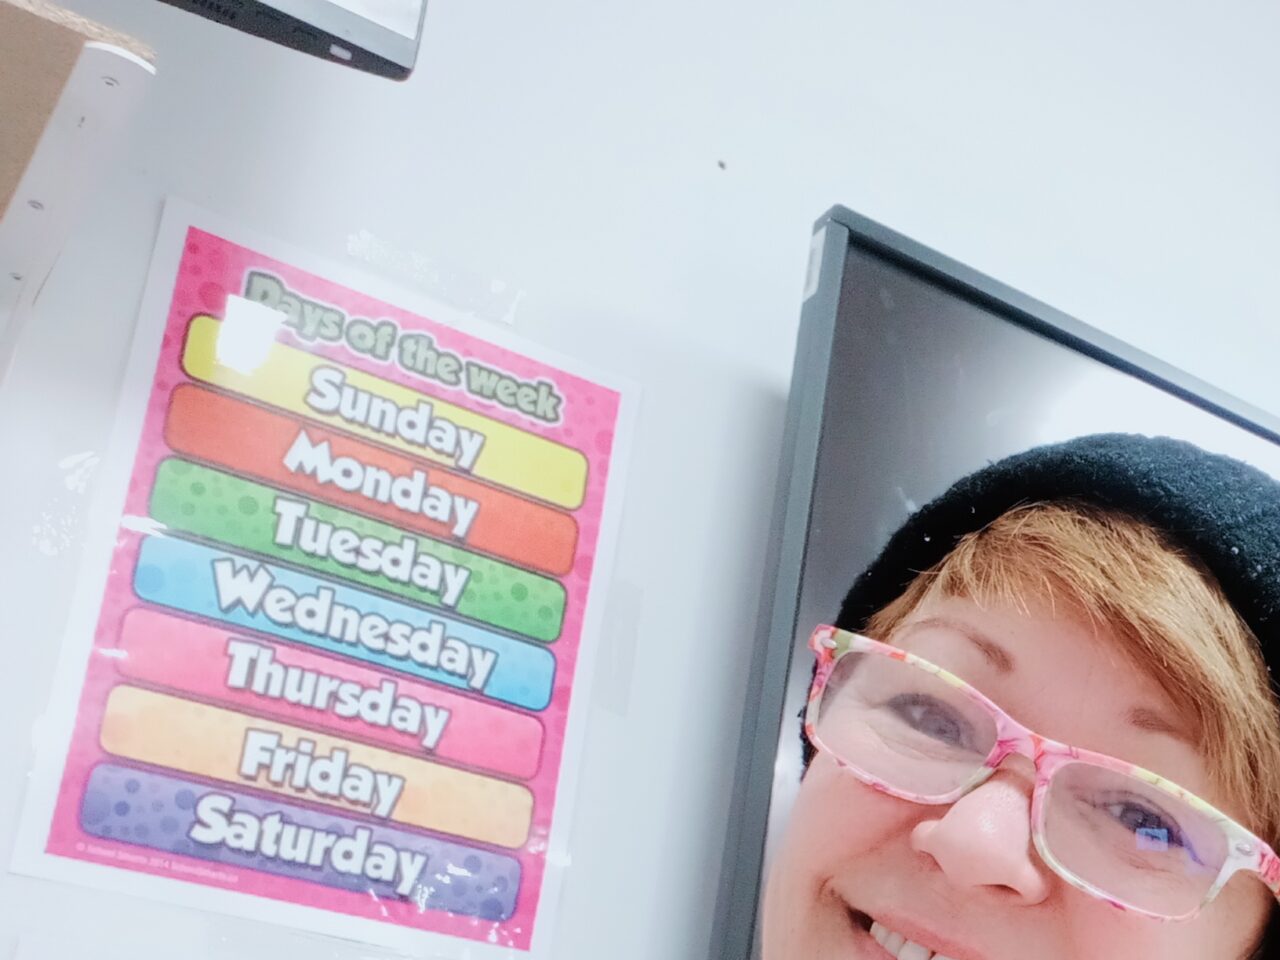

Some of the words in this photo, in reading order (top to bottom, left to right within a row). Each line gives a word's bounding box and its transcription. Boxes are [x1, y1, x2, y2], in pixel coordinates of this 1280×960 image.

[304, 365, 486, 472] Sunday
[345, 319, 398, 362] of
[398, 333, 463, 386] the
[466, 360, 562, 424] week
[283, 429, 480, 541] Monday
[273, 496, 471, 610] Tuesday
[212, 558, 499, 692] Wednesday
[226, 637, 451, 752] Thursday
[239, 728, 404, 819] Friday
[187, 793, 428, 896] Saturday
